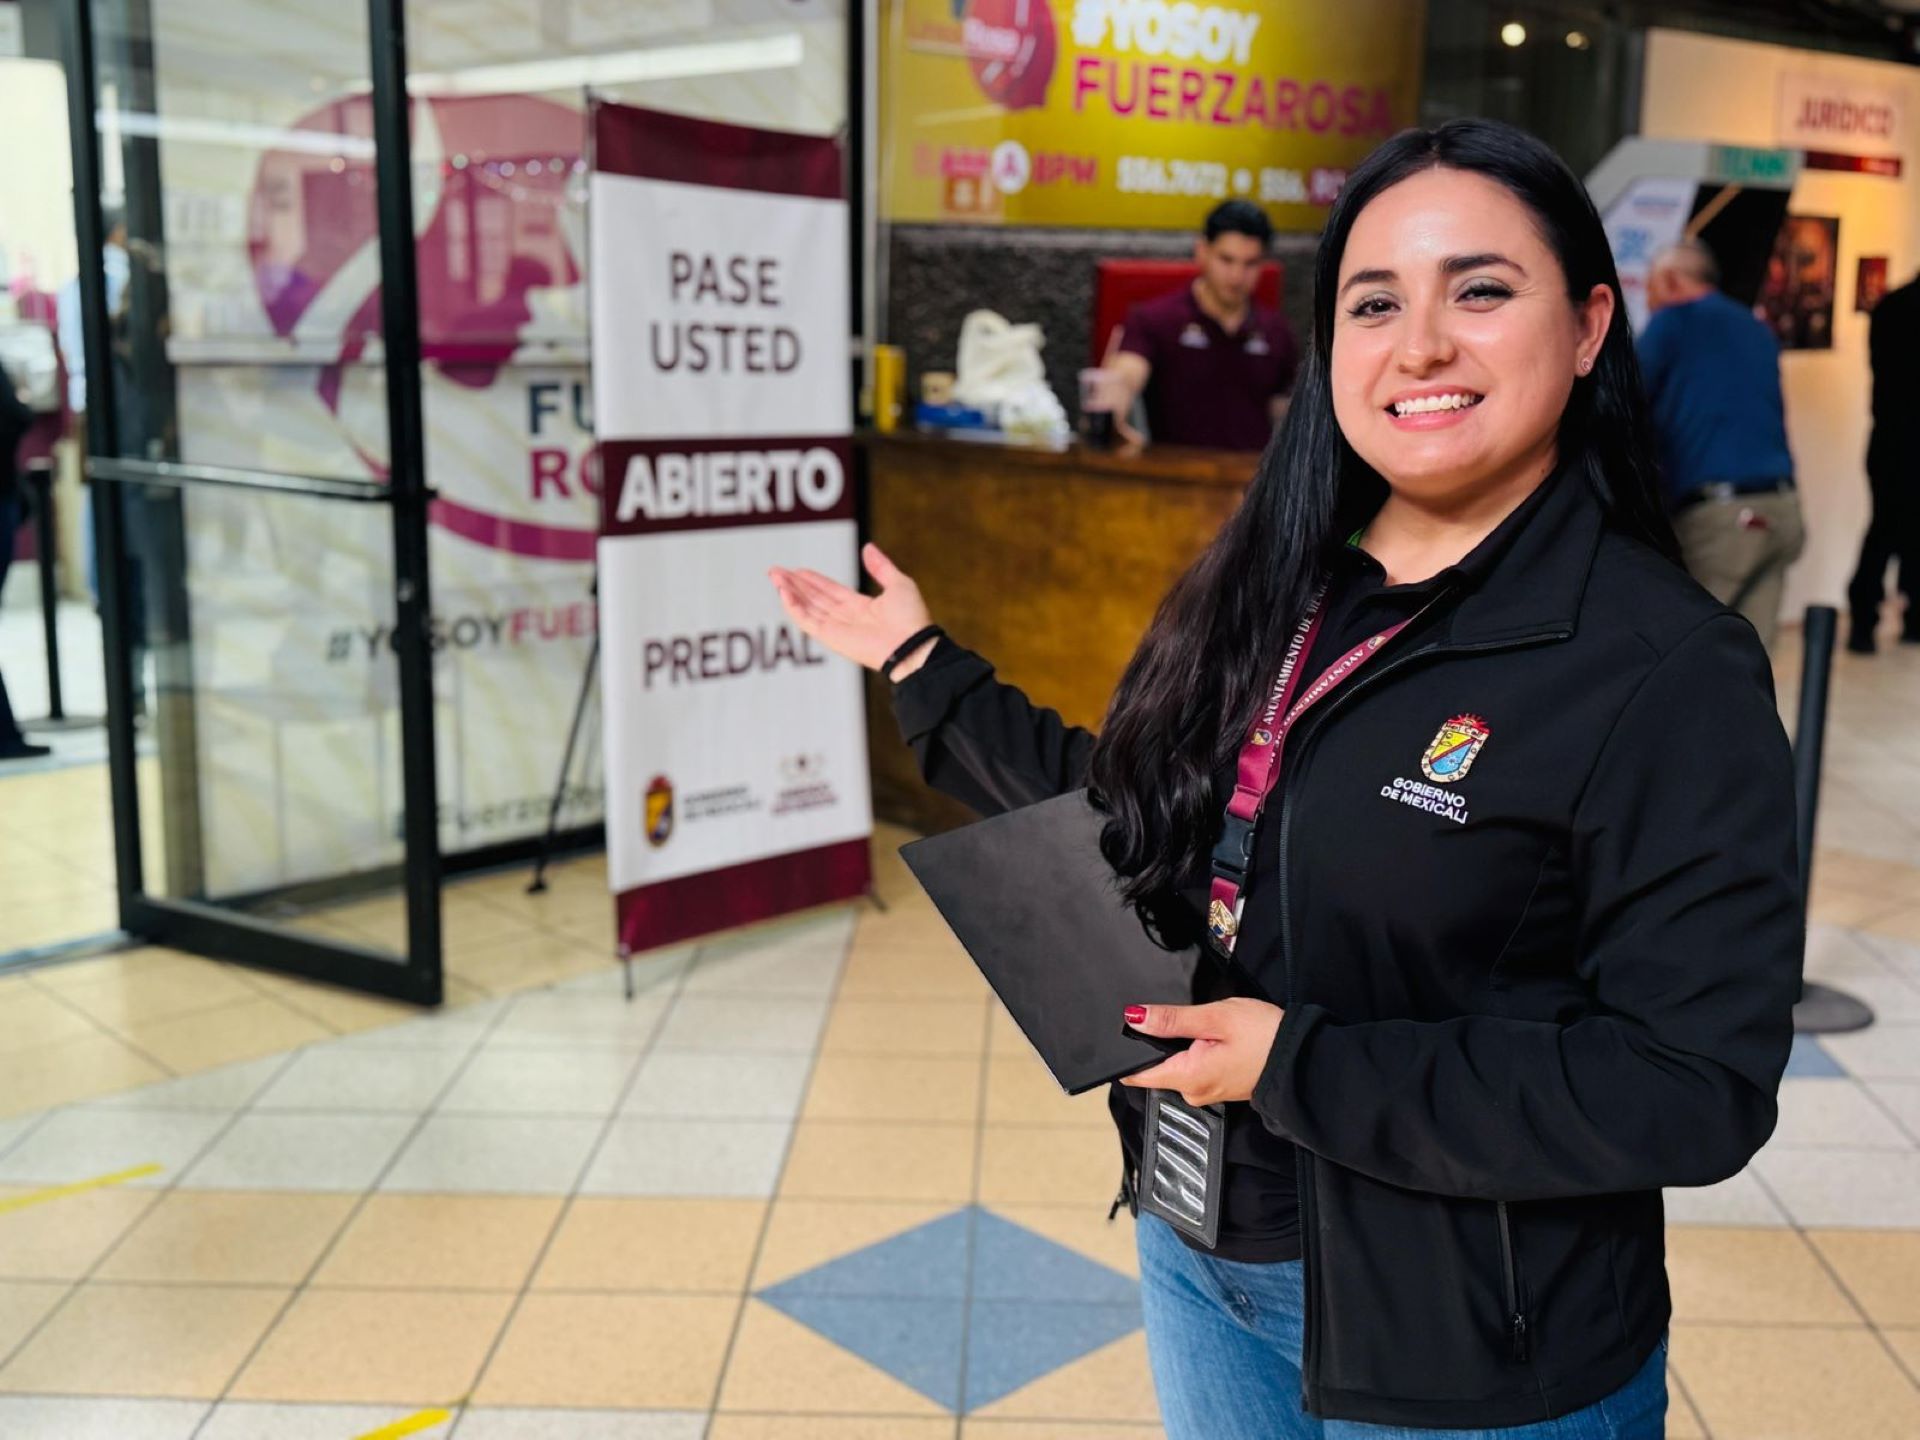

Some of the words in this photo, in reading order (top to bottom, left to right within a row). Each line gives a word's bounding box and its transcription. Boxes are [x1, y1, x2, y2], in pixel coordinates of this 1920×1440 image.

[1073, 57, 1393, 138] FUERZAROSA
[669, 251, 781, 306] PASE
[651, 322, 803, 374] USTED
[616, 447, 845, 522] ABIERTO
[642, 625, 826, 691] PREDIAL
[1262, 632, 1305, 725] AYUNTAMIENTO
[1298, 615, 1315, 634] DE
[1380, 785, 1401, 800] DE
[1399, 791, 1469, 825] MEXICALI
[1392, 776, 1466, 807] GOBIERNO
